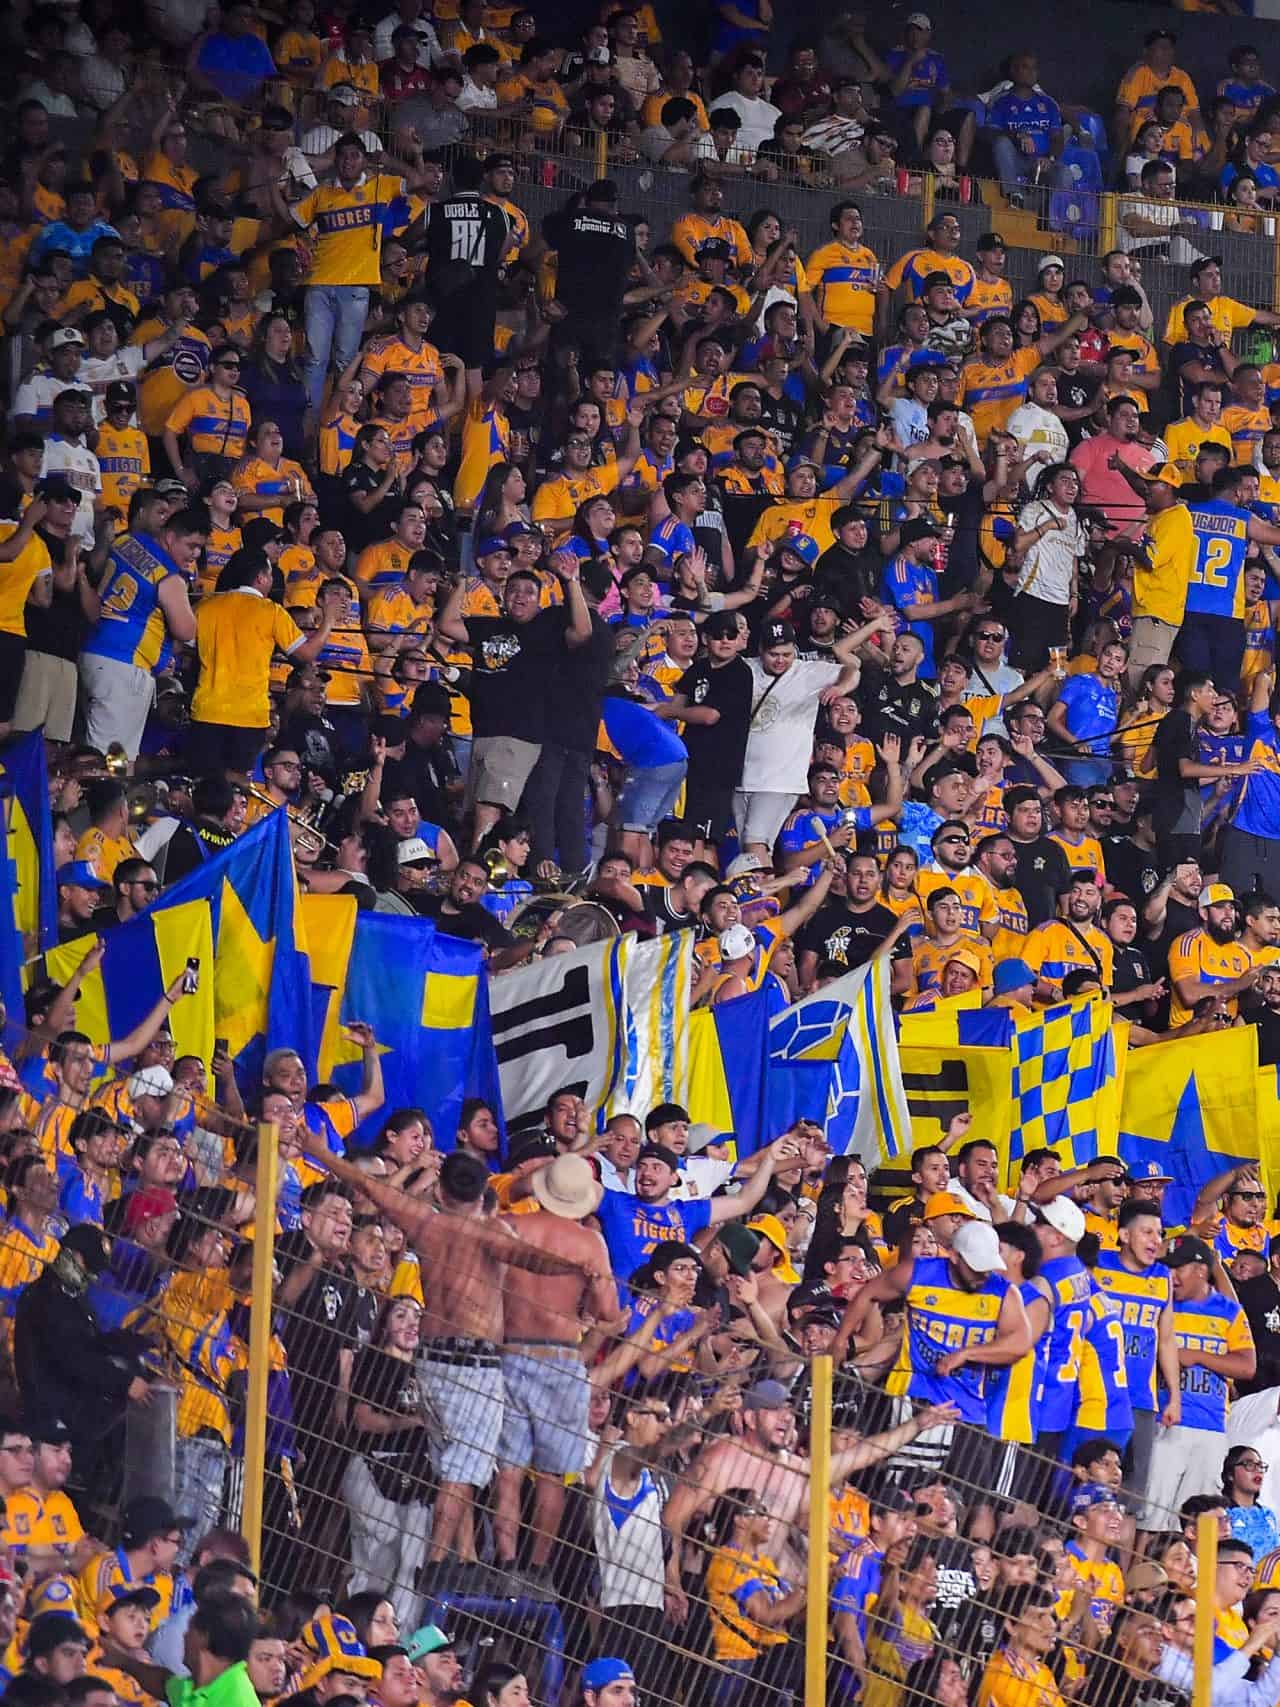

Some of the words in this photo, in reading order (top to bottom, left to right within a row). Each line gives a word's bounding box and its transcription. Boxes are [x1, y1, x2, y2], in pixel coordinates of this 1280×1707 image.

[325, 208, 372, 228] TIGRES
[1190, 535, 1233, 588] 12
[633, 1218, 685, 1243] TIGRES
